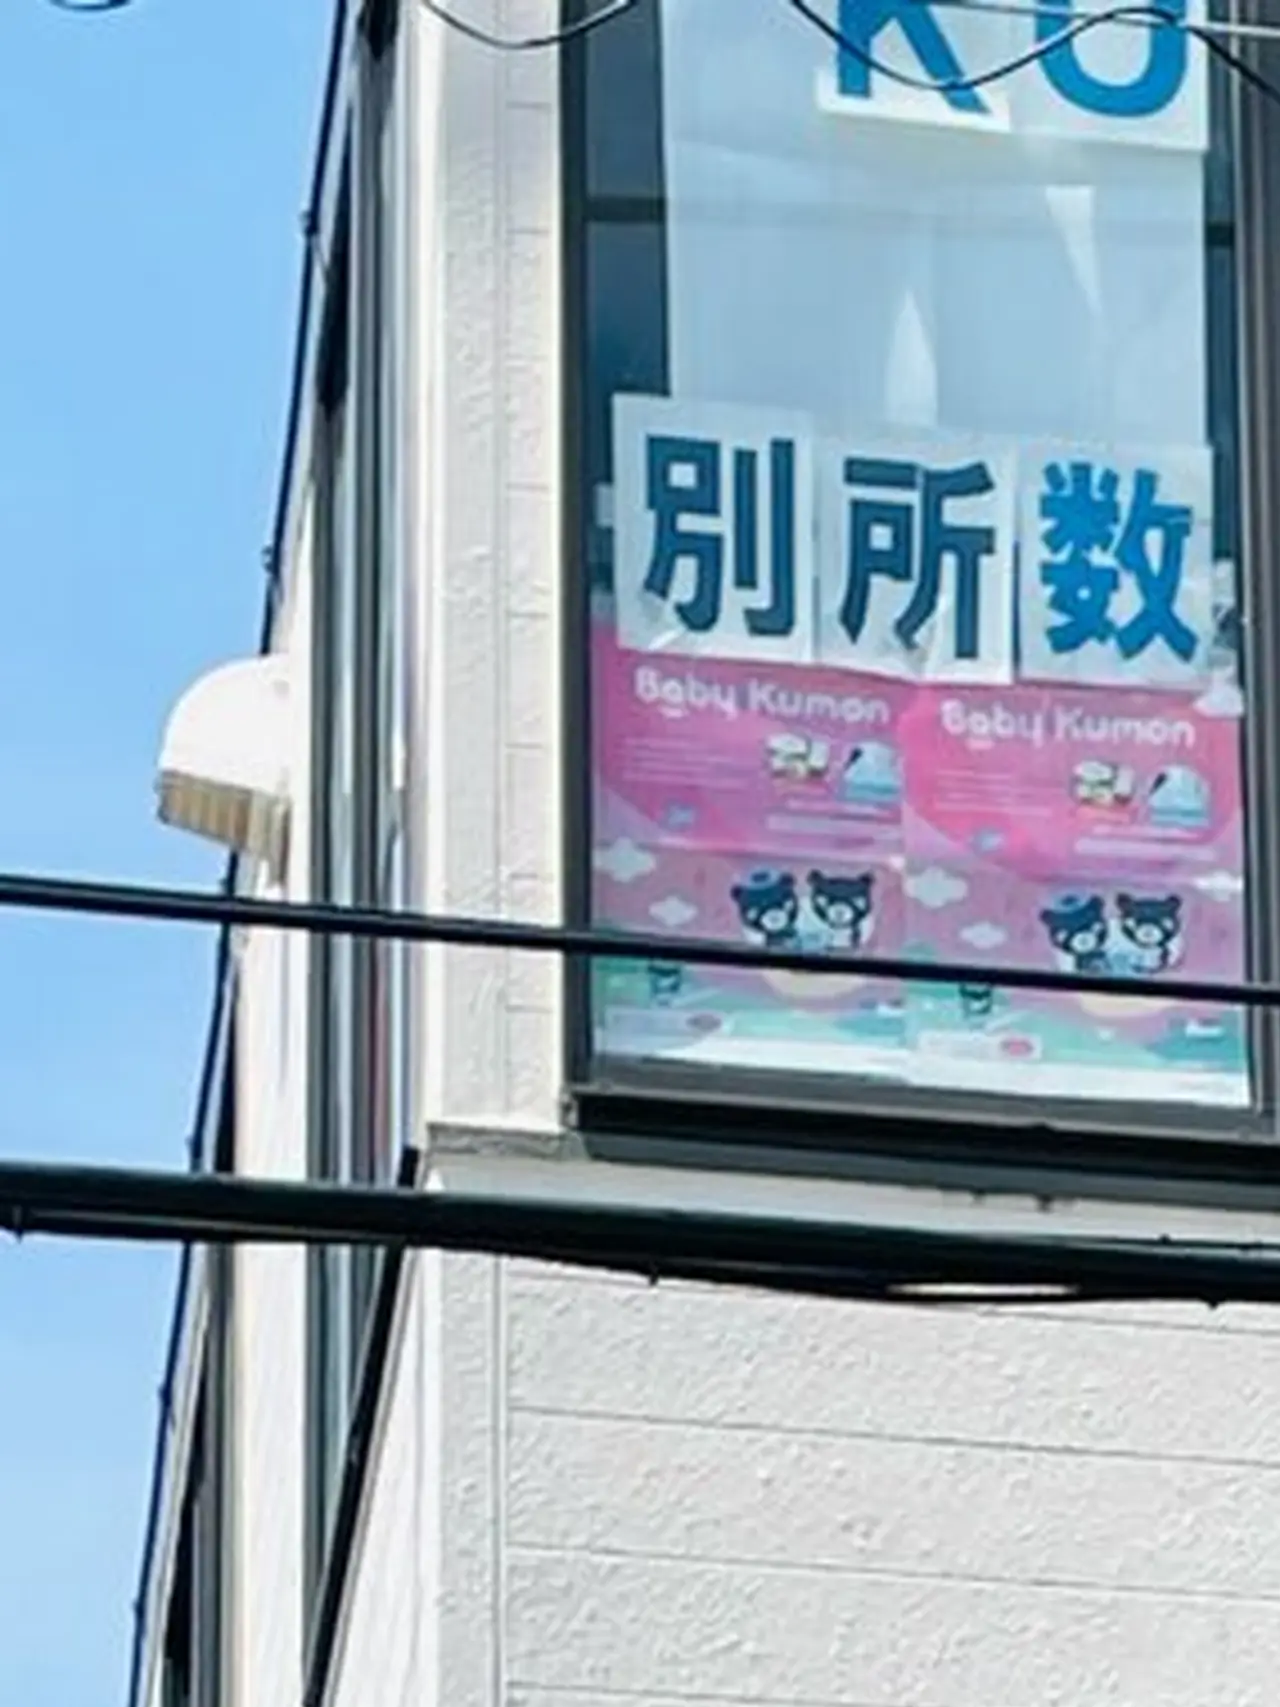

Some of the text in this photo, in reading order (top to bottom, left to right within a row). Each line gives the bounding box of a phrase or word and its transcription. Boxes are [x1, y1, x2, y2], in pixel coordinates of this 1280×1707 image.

[644, 435, 1199, 662] 別所数
[635, 669, 891, 725] Baby Kumon
[941, 700, 1196, 747] Baby Kumon
